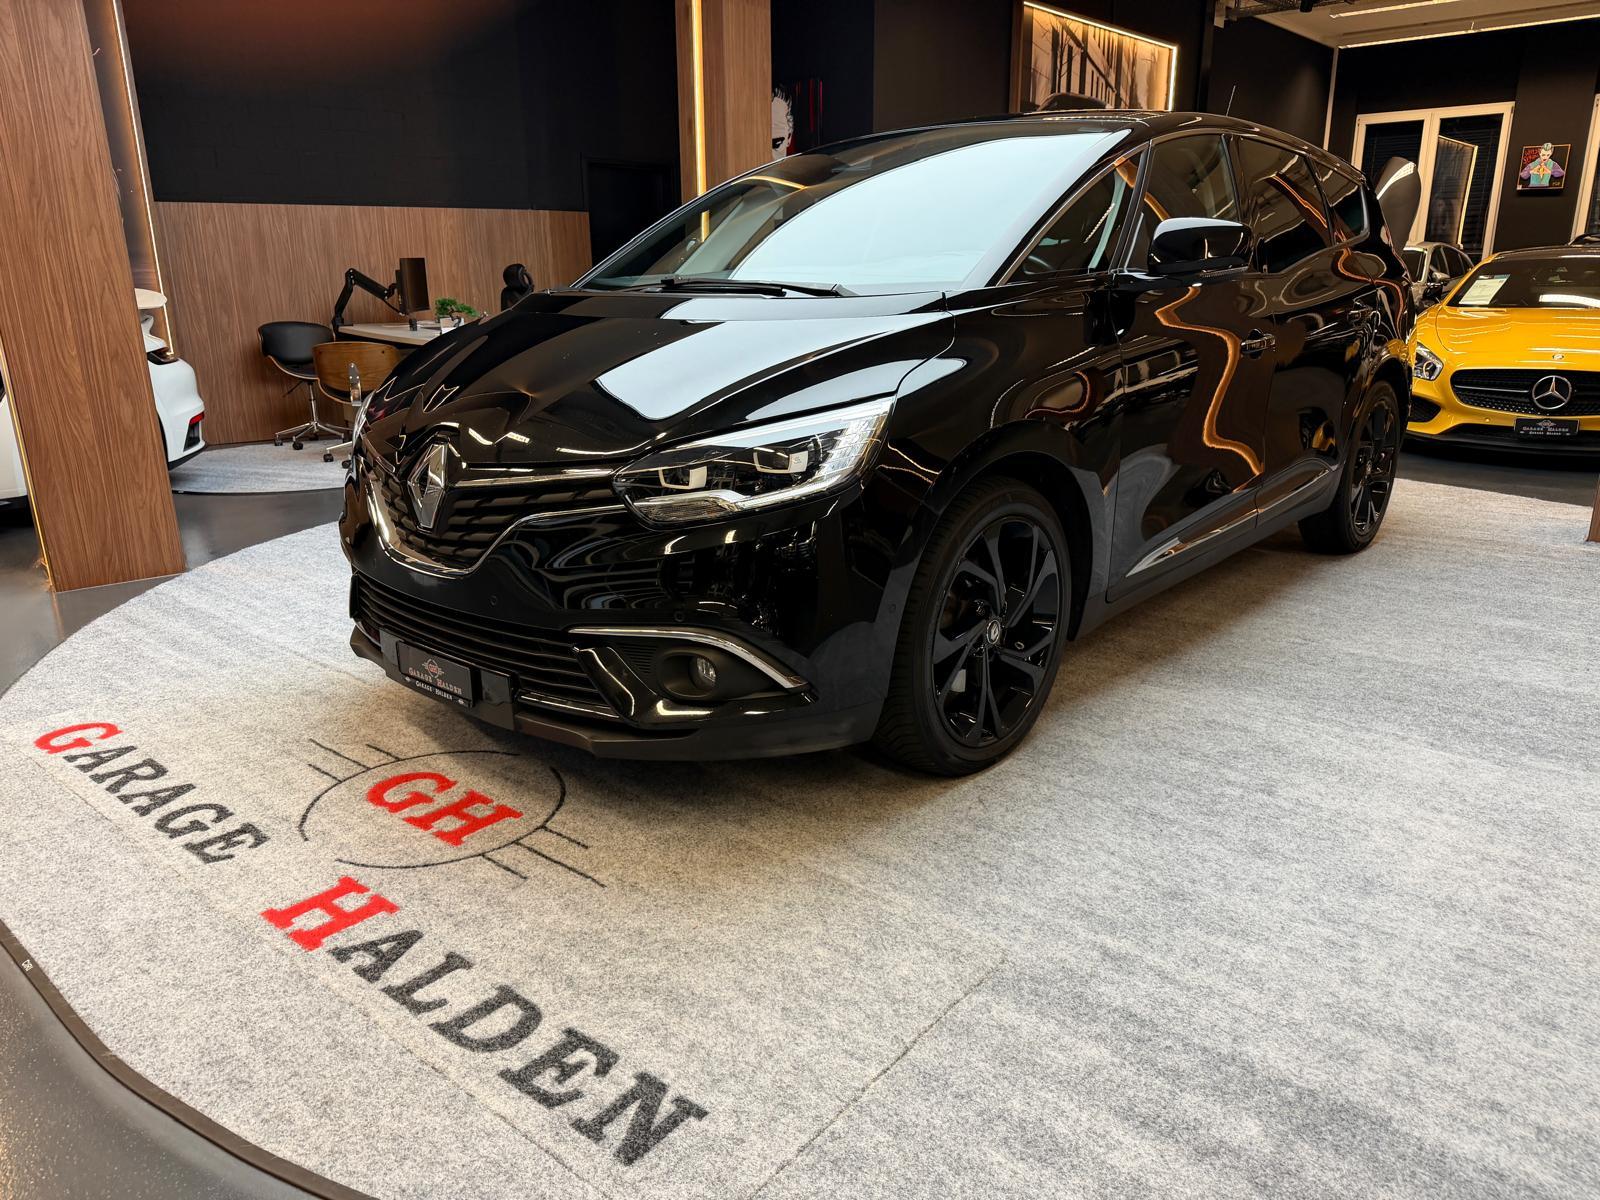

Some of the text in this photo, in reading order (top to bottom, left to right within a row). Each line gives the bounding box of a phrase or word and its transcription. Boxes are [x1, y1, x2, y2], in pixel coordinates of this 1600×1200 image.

[366, 771, 524, 847] GH
[34, 721, 709, 1166] GARAGE HALDEN
